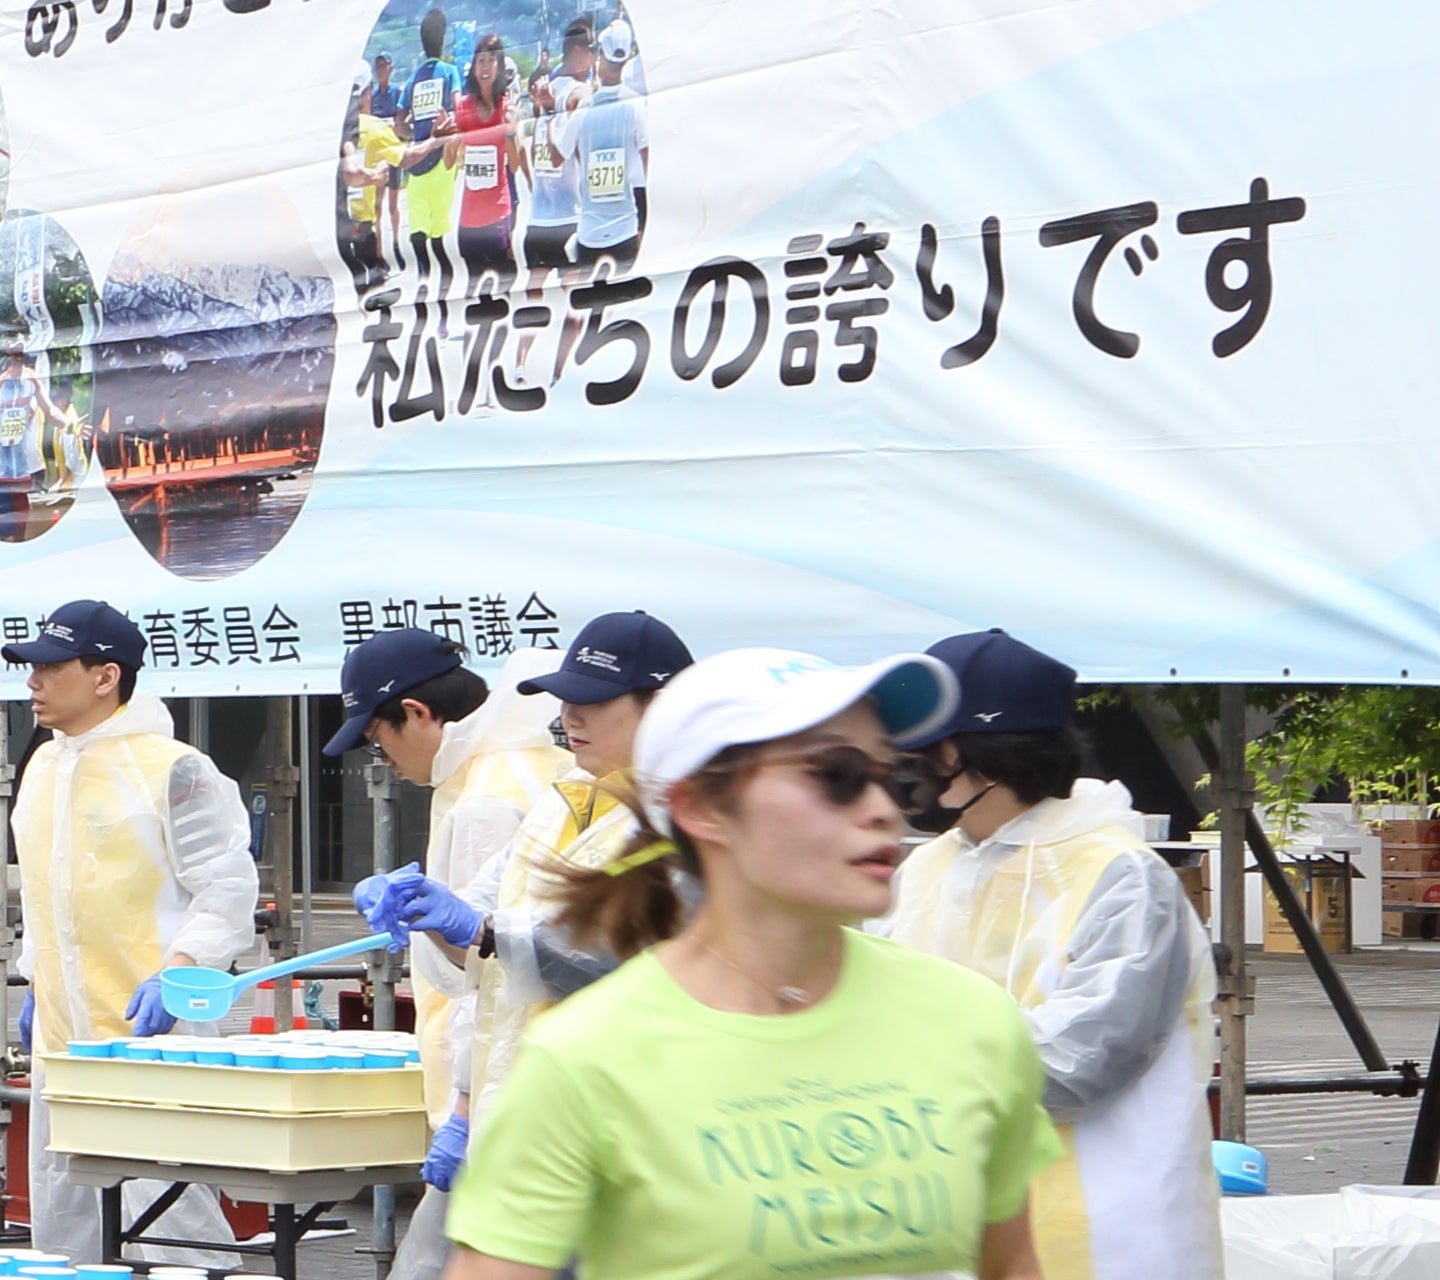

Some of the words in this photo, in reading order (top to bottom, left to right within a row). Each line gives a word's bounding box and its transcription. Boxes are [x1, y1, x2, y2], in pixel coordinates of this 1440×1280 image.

[355, 176, 1307, 429] 私たちの誇りです
